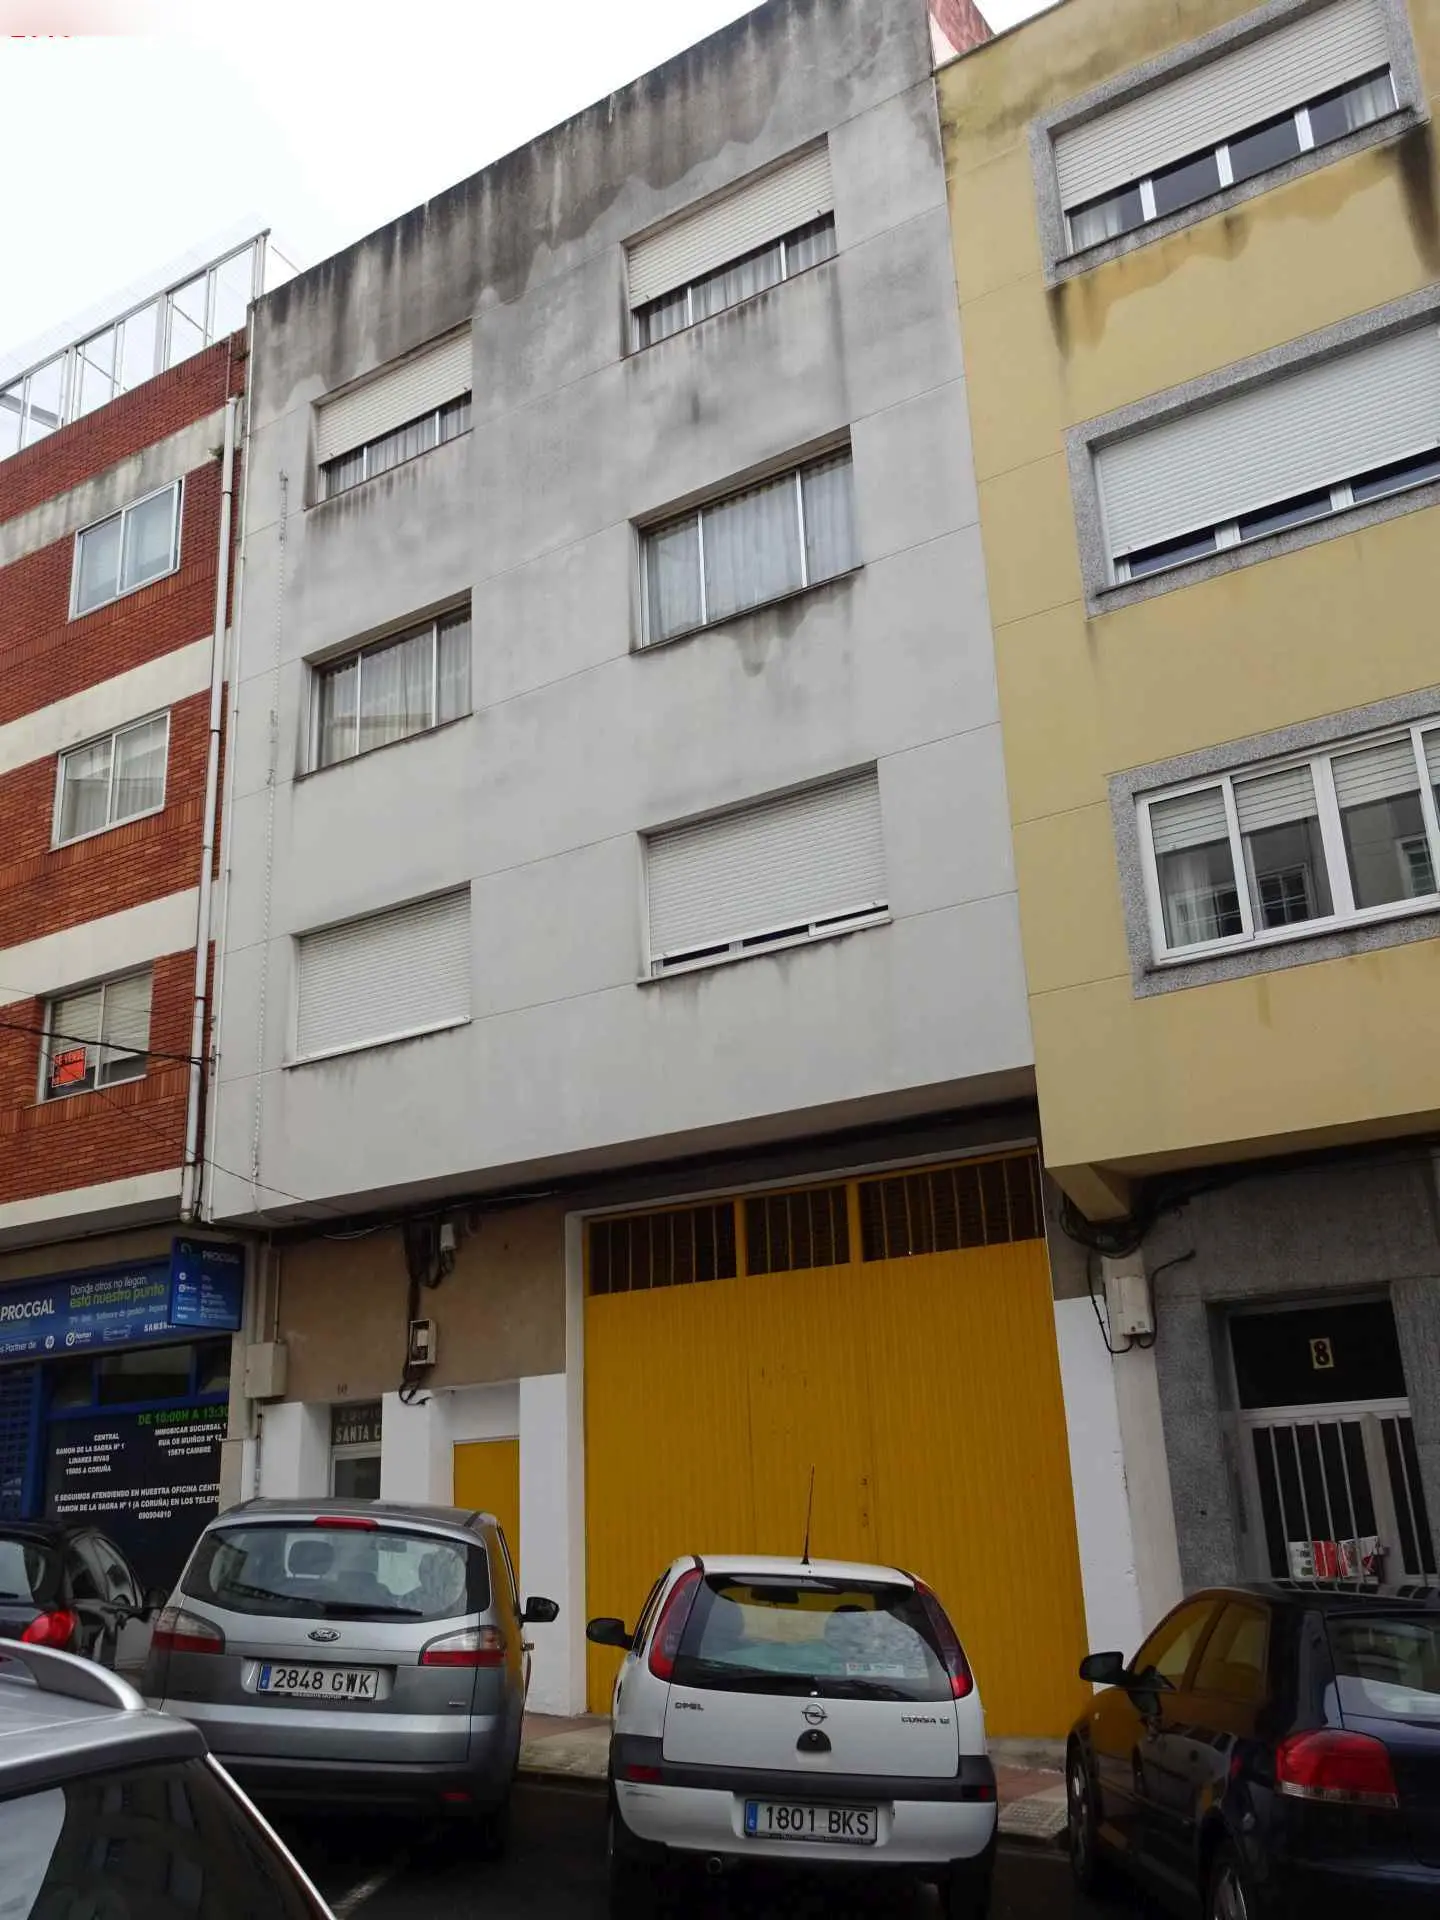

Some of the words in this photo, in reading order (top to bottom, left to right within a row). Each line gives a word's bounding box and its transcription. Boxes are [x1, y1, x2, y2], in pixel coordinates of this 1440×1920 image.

[70, 1282, 94, 1297] Donde
[94, 1281, 113, 1292] otros
[113, 1279, 124, 1289] no
[93, 1289, 130, 1304] nuestro
[132, 1284, 165, 1303] punto
[0, 1297, 55, 1322] PROCGAL
[1314, 1340, 1330, 1366] 8
[137, 1413, 151, 1426] DE
[191, 1409, 200, 1420] A
[189, 1423, 221, 1433] SUCURSAL
[335, 1424, 369, 1444] SANTA
[94, 1433, 120, 1442] CENTRAL
[76, 1446, 85, 1454] DE
[85, 1445, 93, 1453] LA
[87, 1463, 112, 1474] CORUÑA
[60, 1491, 91, 1501] SEGUIMOS
[91, 1489, 130, 1500] ATENDIENDO
[131, 1488, 140, 1497] EN
[141, 1486, 170, 1497] NUESTRA
[171, 1484, 197, 1495] OFICINA
[79, 1503, 87, 1512] DE
[88, 1503, 97, 1512] LA
[97, 1502, 118, 1512] SAGRA
[170, 1497, 179, 1506] EN
[181, 1496, 194, 1505] LOS
[273, 1668, 324, 1690] 2848
[331, 1671, 372, 1694] GWK
[765, 1806, 816, 1833] 1801
[828, 1810, 869, 1836] BKS
